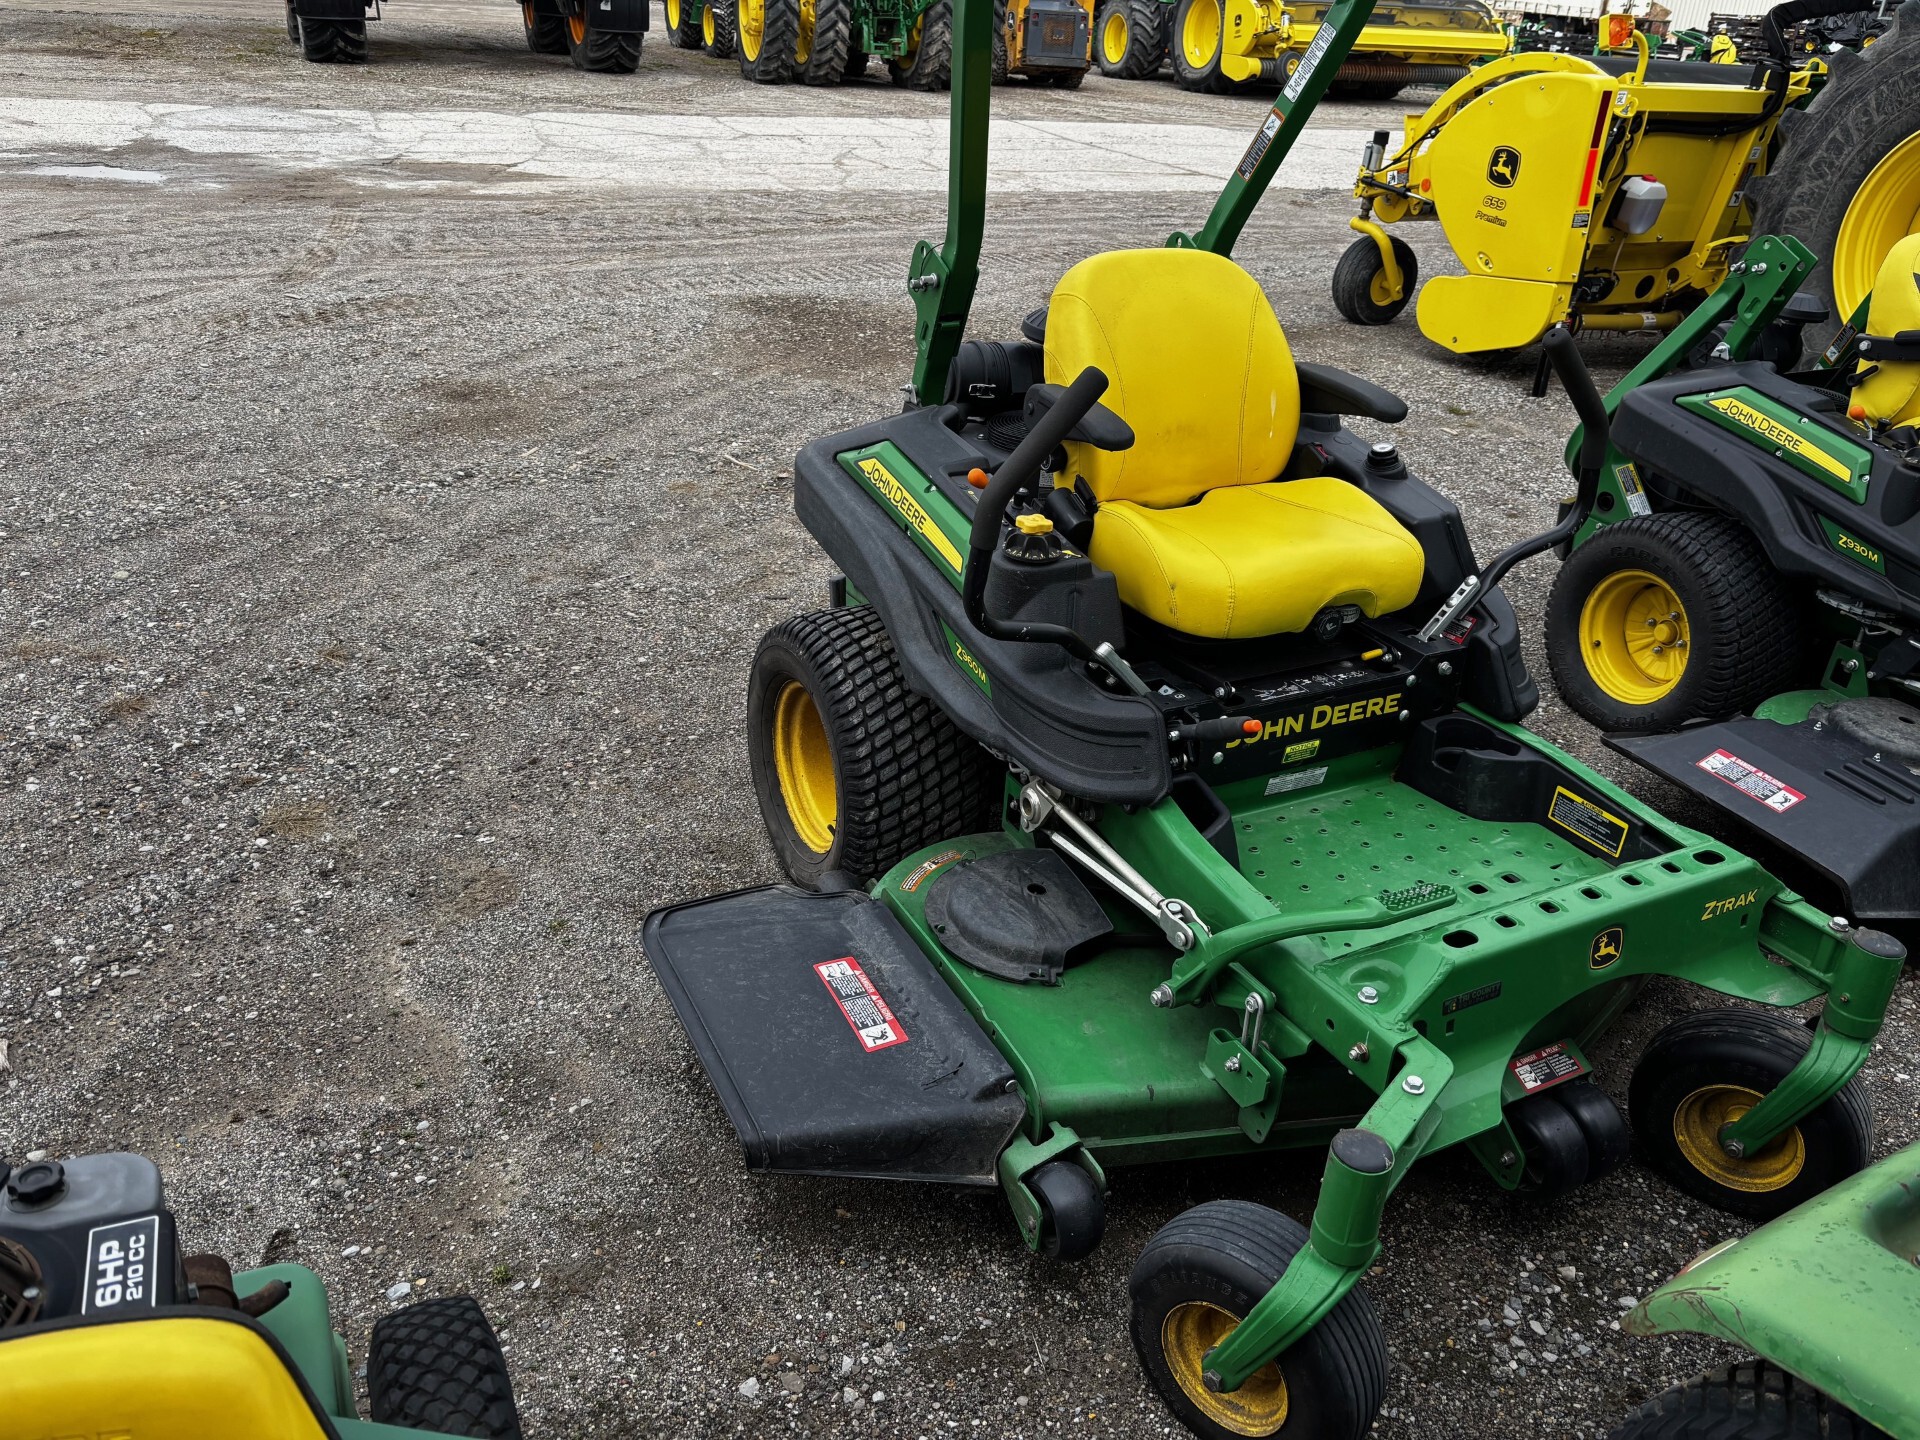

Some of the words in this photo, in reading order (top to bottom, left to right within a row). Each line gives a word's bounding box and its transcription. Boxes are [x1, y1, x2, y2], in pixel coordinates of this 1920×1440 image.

[1475, 210, 1507, 227] Premium
[1482, 195, 1506, 211] 659
[1722, 401, 1756, 426] JOHN
[1758, 418, 1803, 451] DEERE
[866, 463, 893, 496] JOHN
[893, 487, 927, 531] DEERE
[1838, 534, 1878, 563] Z930M
[955, 641, 986, 684] Z960M
[1311, 693, 1401, 730] DEERE
[1701, 889, 1758, 921] ZTRAK
[859, 974, 875, 993] DANGER
[875, 998, 892, 1021] PELIGRO
[128, 1234, 146, 1262] CC
[95, 1240, 125, 1308] 6HP
[126, 1264, 144, 1301] 210
